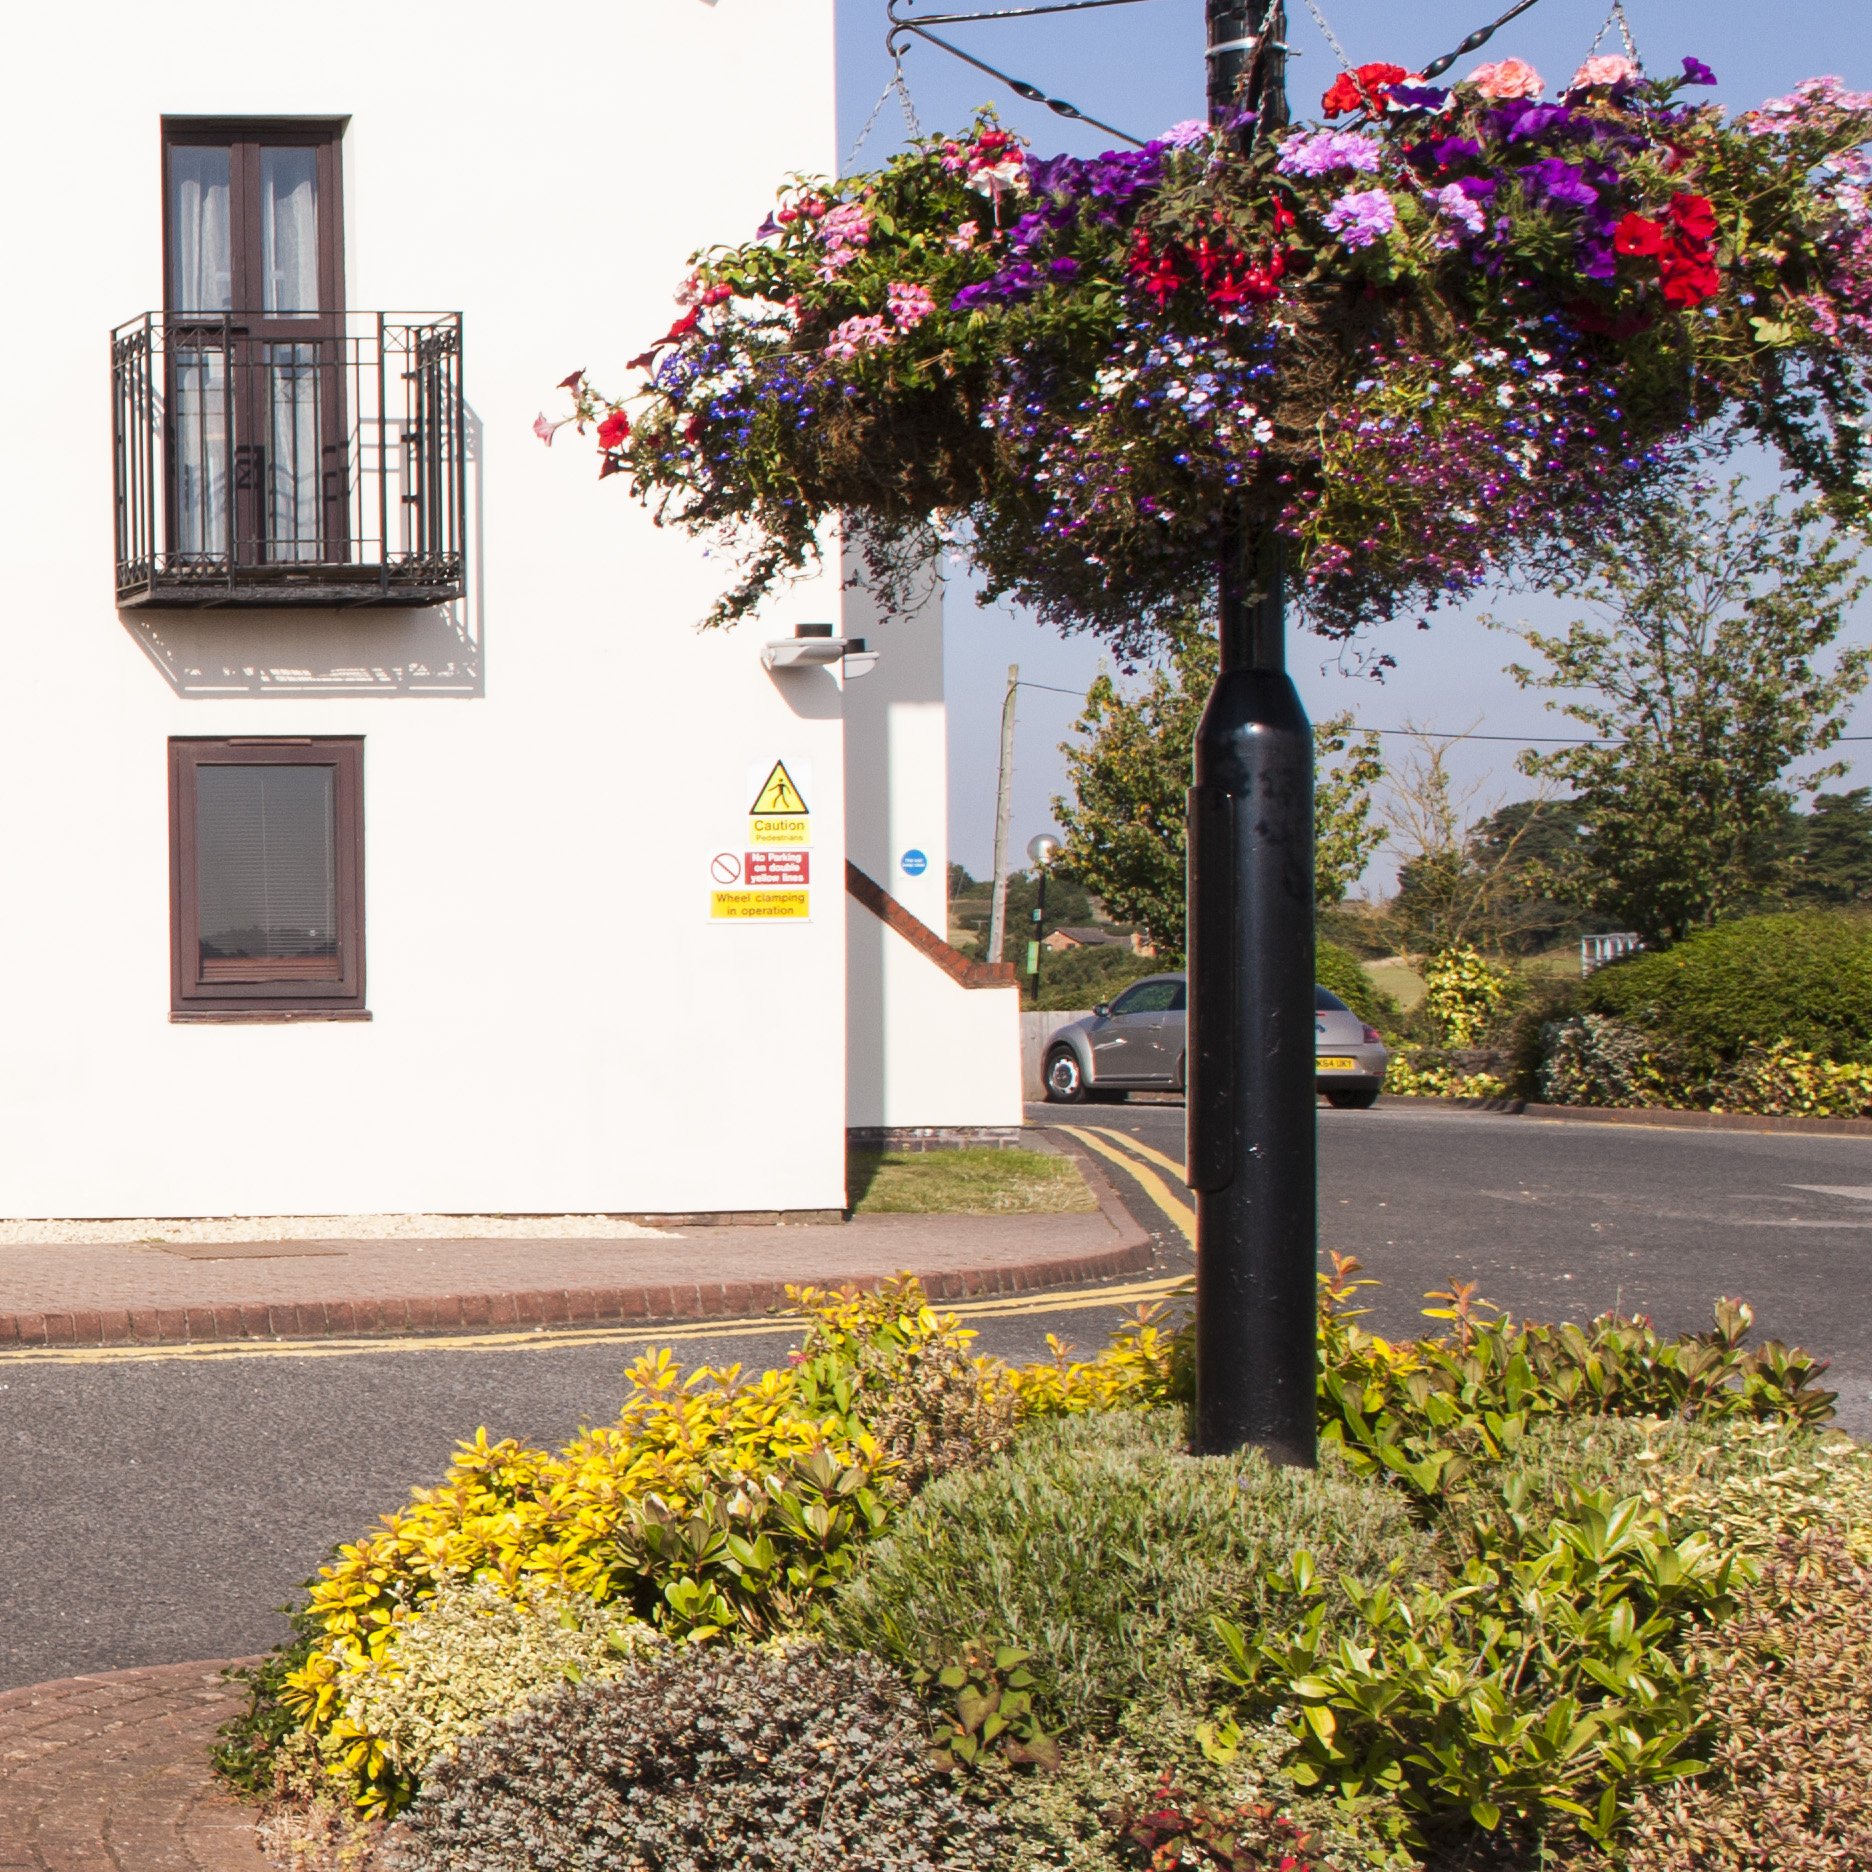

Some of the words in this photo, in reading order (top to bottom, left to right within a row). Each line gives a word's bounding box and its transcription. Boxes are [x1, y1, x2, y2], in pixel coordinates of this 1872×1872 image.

[754, 820, 805, 831] Caution
[751, 853, 766, 862] No
[767, 853, 802, 863] Parking
[753, 864, 767, 872] on
[768, 862, 801, 872] double
[750, 873, 780, 884] yellow
[781, 872, 805, 882] lines
[716, 893, 751, 903] Wheel
[755, 893, 805, 904] clamping
[727, 907, 737, 915] in
[741, 907, 794, 917] operation
